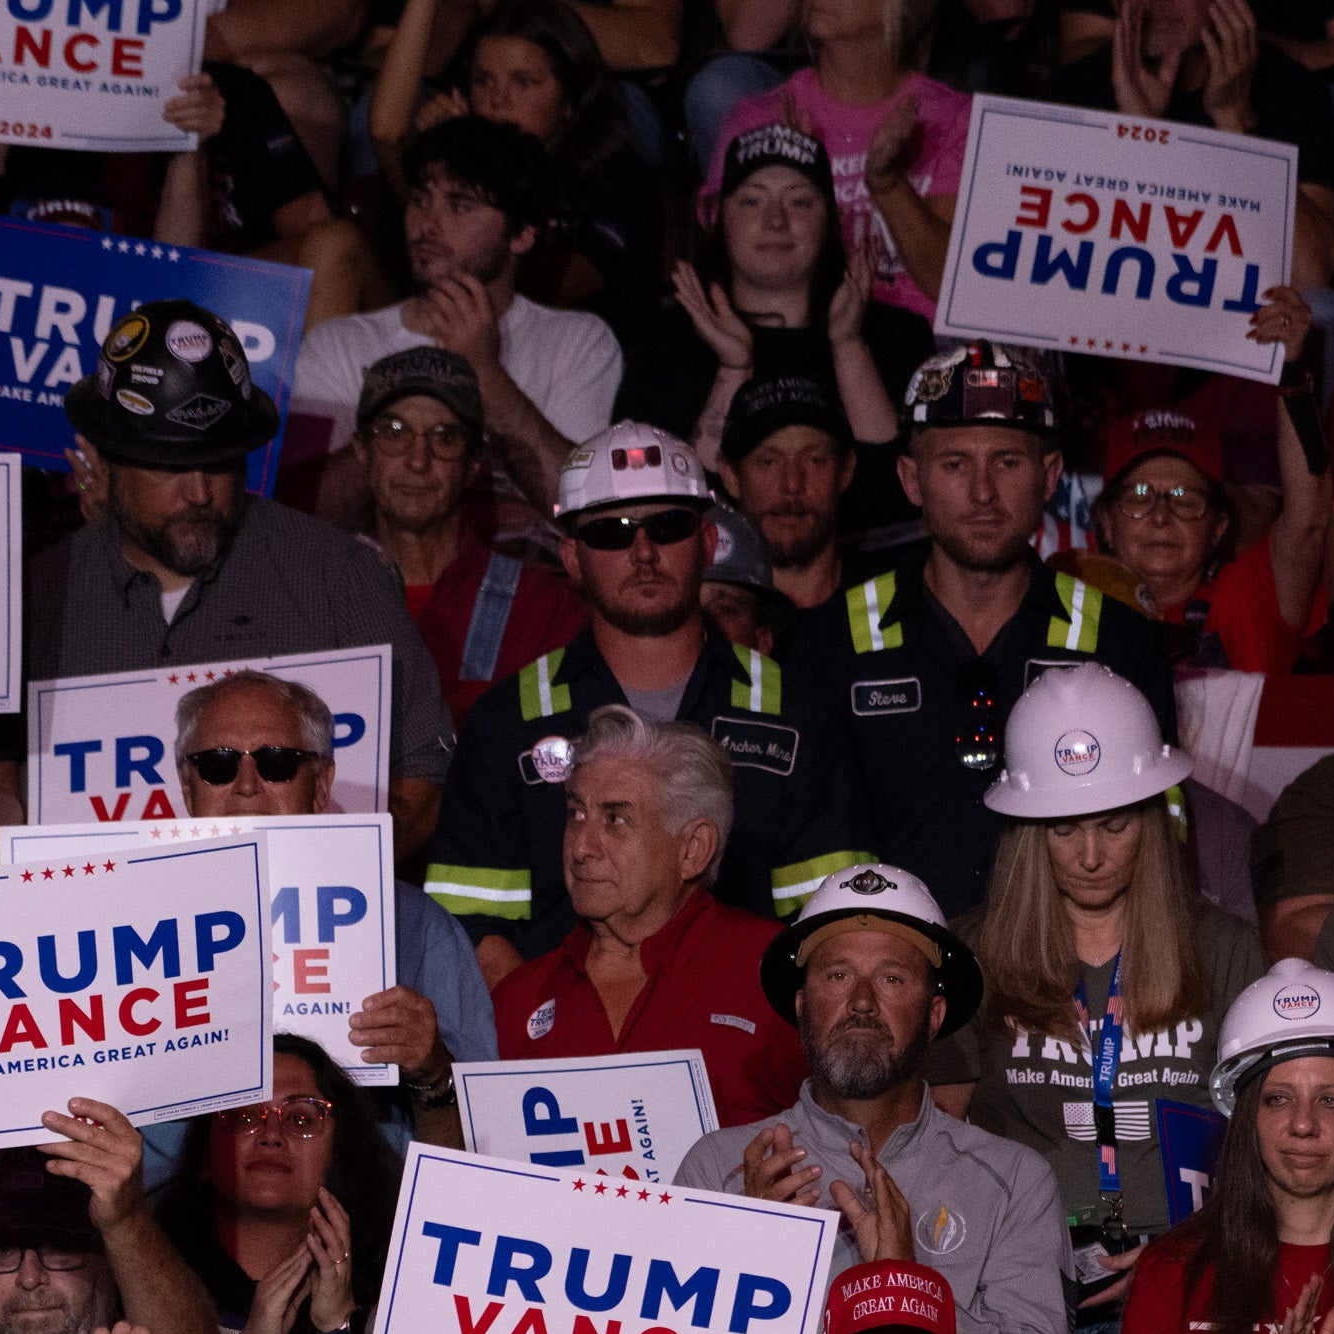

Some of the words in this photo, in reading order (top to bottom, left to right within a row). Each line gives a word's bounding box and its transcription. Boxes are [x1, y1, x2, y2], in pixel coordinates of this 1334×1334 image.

[0, 121, 52, 138] 2024
[1117, 124, 1169, 144] 2024
[736, 144, 815, 164] TRUMP
[1016, 186, 1243, 256] VANCE
[973, 230, 1262, 314] TRUMP
[868, 689, 908, 707] Steve
[718, 735, 761, 756] Archer
[766, 743, 792, 760] Mine
[1061, 752, 1095, 763] VANCE
[1277, 995, 1318, 1006] TRUMP
[1281, 1001, 1315, 1009] VANCE
[94, 1043, 156, 1063] GREAT
[165, 1029, 228, 1052] AGAIN!
[1099, 1036, 1116, 1083] TRUMP
[1006, 1068, 1047, 1085] Make
[1117, 1069, 1158, 1086] Great
[1161, 1069, 1199, 1086] Again
[423, 1222, 791, 1334] TRUMP
[841, 1276, 881, 1302] MAKE
[886, 1271, 943, 1303] AMERICA
[852, 1296, 898, 1321] GREAT
[900, 1295, 938, 1322] AGAIN
